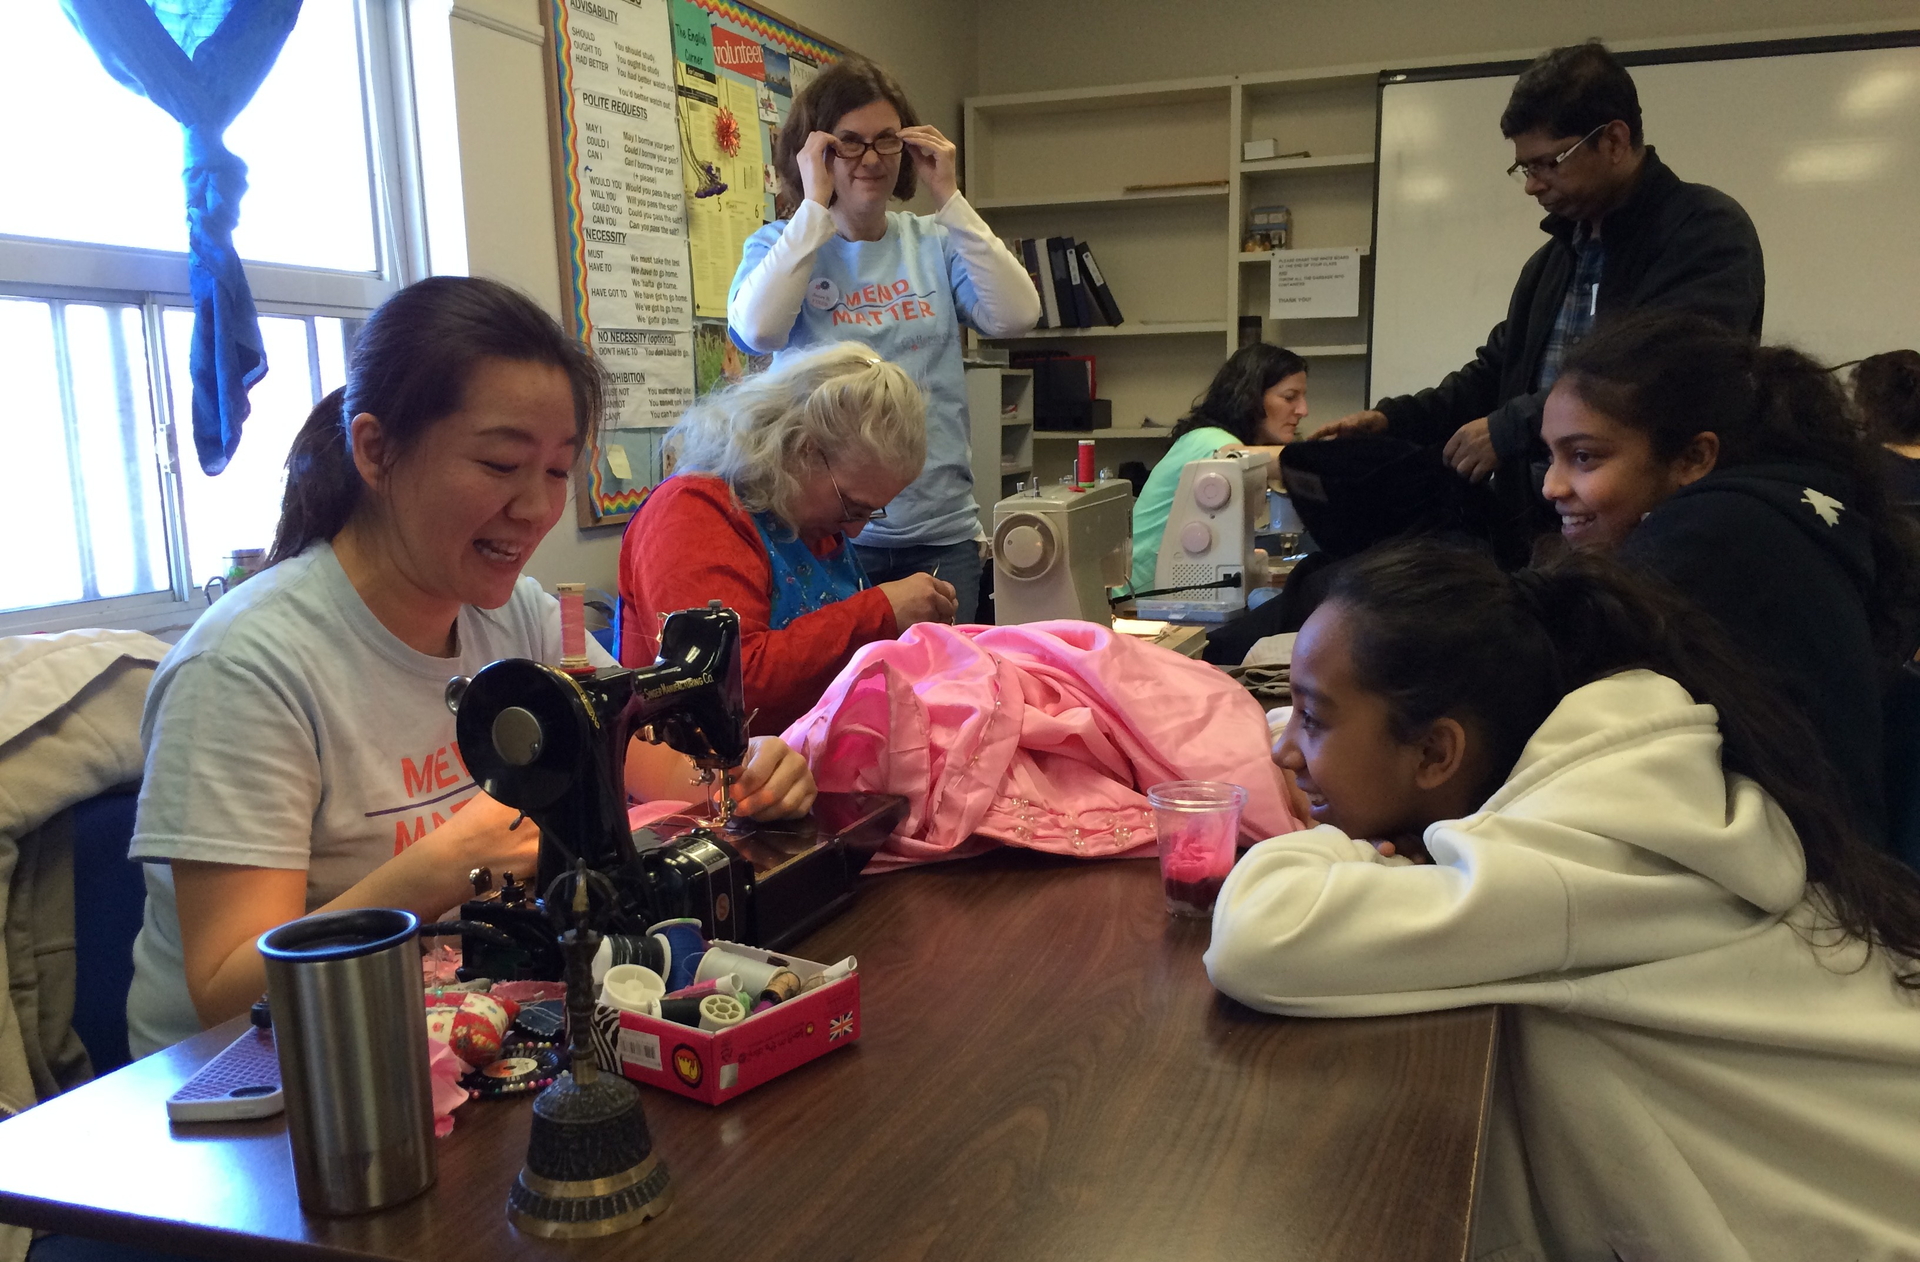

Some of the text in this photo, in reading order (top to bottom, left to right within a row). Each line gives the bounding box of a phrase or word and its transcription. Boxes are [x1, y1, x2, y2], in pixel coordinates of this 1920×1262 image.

[570, 0, 618, 23] ADVISABILITY
[572, 26, 596, 42] SHOULD
[675, 23, 687, 39] The
[573, 40, 602, 56] OUGHT TO
[714, 40, 764, 64] volunteer
[576, 54, 609, 72] HAD BETTER
[582, 92, 648, 120] POLITE REQUESTS
[585, 122, 599, 133] MAY
[586, 136, 606, 148] COULD
[587, 149, 600, 160] CAN
[588, 175, 622, 190] WOULD YOU
[590, 188, 617, 202] WILL YOU
[592, 202, 623, 215] COULD YOU
[717, 196, 722, 213] 5
[754, 204, 760, 219] 6
[592, 215, 617, 227] CAN YOU
[586, 228, 628, 244] NECESSITY
[588, 249, 604, 259] MUST
[588, 262, 612, 272] HAVE TO
[591, 288, 628, 298] HAVE GOT TO
[844, 278, 910, 308] MEND
[832, 300, 936, 327] MATTER
[598, 332, 609, 342] NO
[610, 332, 647, 344] NECESSITY
[616, 348, 631, 356] HAVE
[631, 348, 638, 356] TO
[618, 388, 630, 396] NOT
